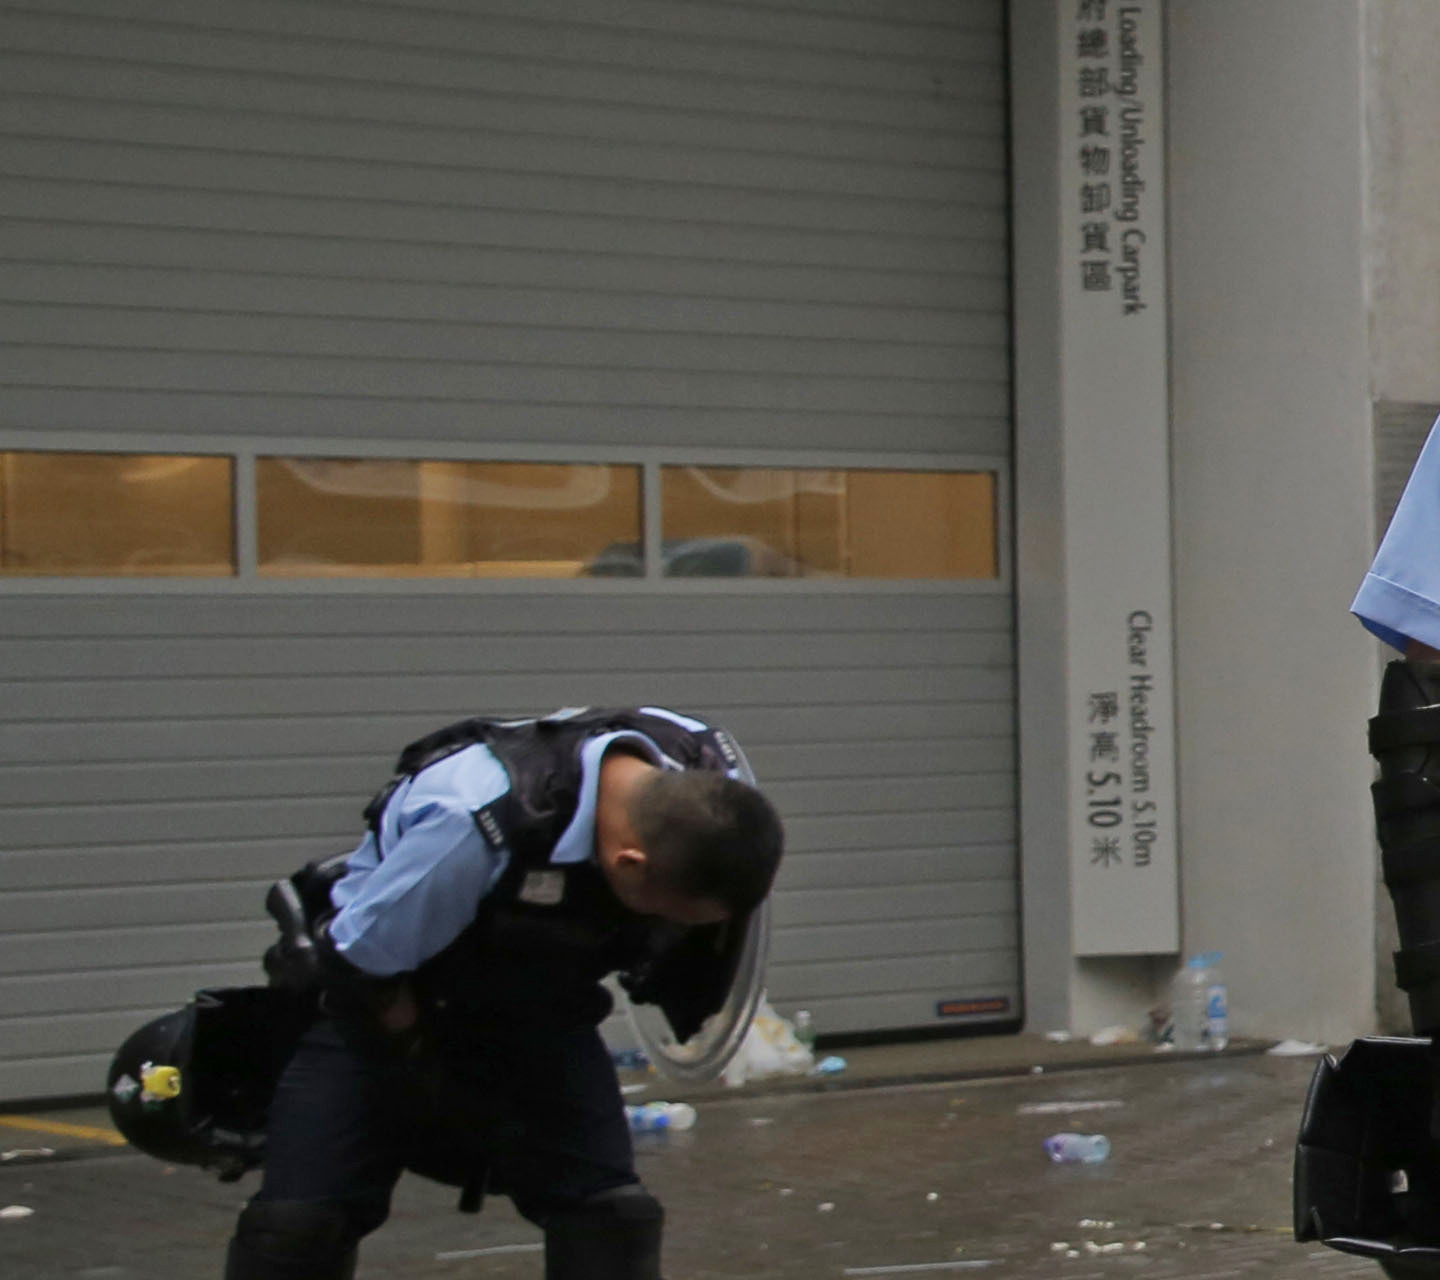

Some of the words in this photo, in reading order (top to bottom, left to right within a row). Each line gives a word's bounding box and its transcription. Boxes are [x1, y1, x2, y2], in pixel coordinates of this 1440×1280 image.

[1115, 7, 1145, 222] Loading/Unloading
[1116, 228, 1148, 316] Carpark
[1127, 610, 1153, 667] Clear
[1129, 674, 1155, 793] Headroom
[1132, 800, 1157, 868] 5.10m
